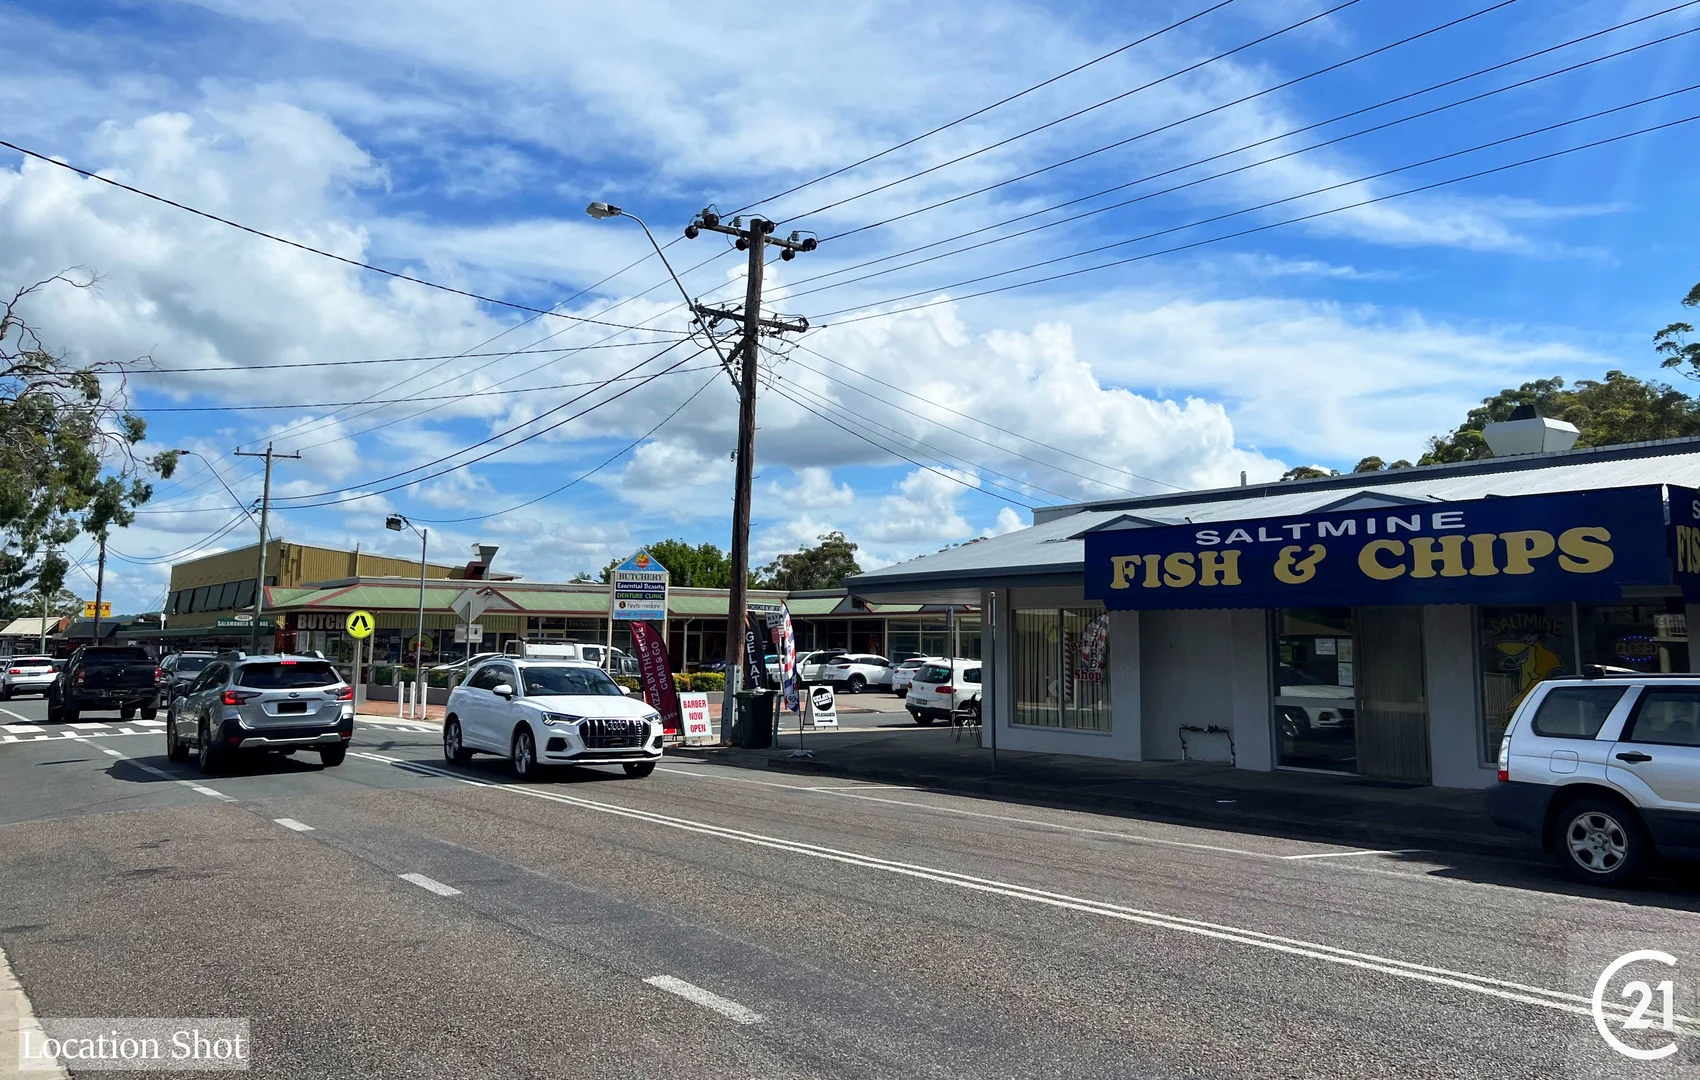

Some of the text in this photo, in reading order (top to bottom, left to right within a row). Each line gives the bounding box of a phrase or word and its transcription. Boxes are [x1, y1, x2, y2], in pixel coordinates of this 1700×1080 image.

[1195, 510, 1466, 546] SALTMINE
[1110, 526, 1614, 589] FISH & CHIPS
[297, 614, 348, 630] BUTCH
[1491, 613, 1563, 636] SALTMINE
[636, 626, 648, 652] SLICE
[1615, 642, 1658, 655] CLOSED
[642, 652, 652, 671] THE
[651, 641, 668, 690] GRAB & GO
[745, 631, 761, 687] GELAT
[646, 671, 656, 684] BY
[1074, 668, 1102, 684] Shop
[683, 700, 707, 709] BARBER
[689, 712, 703, 721] NOW
[690, 724, 706, 733] OPEN
